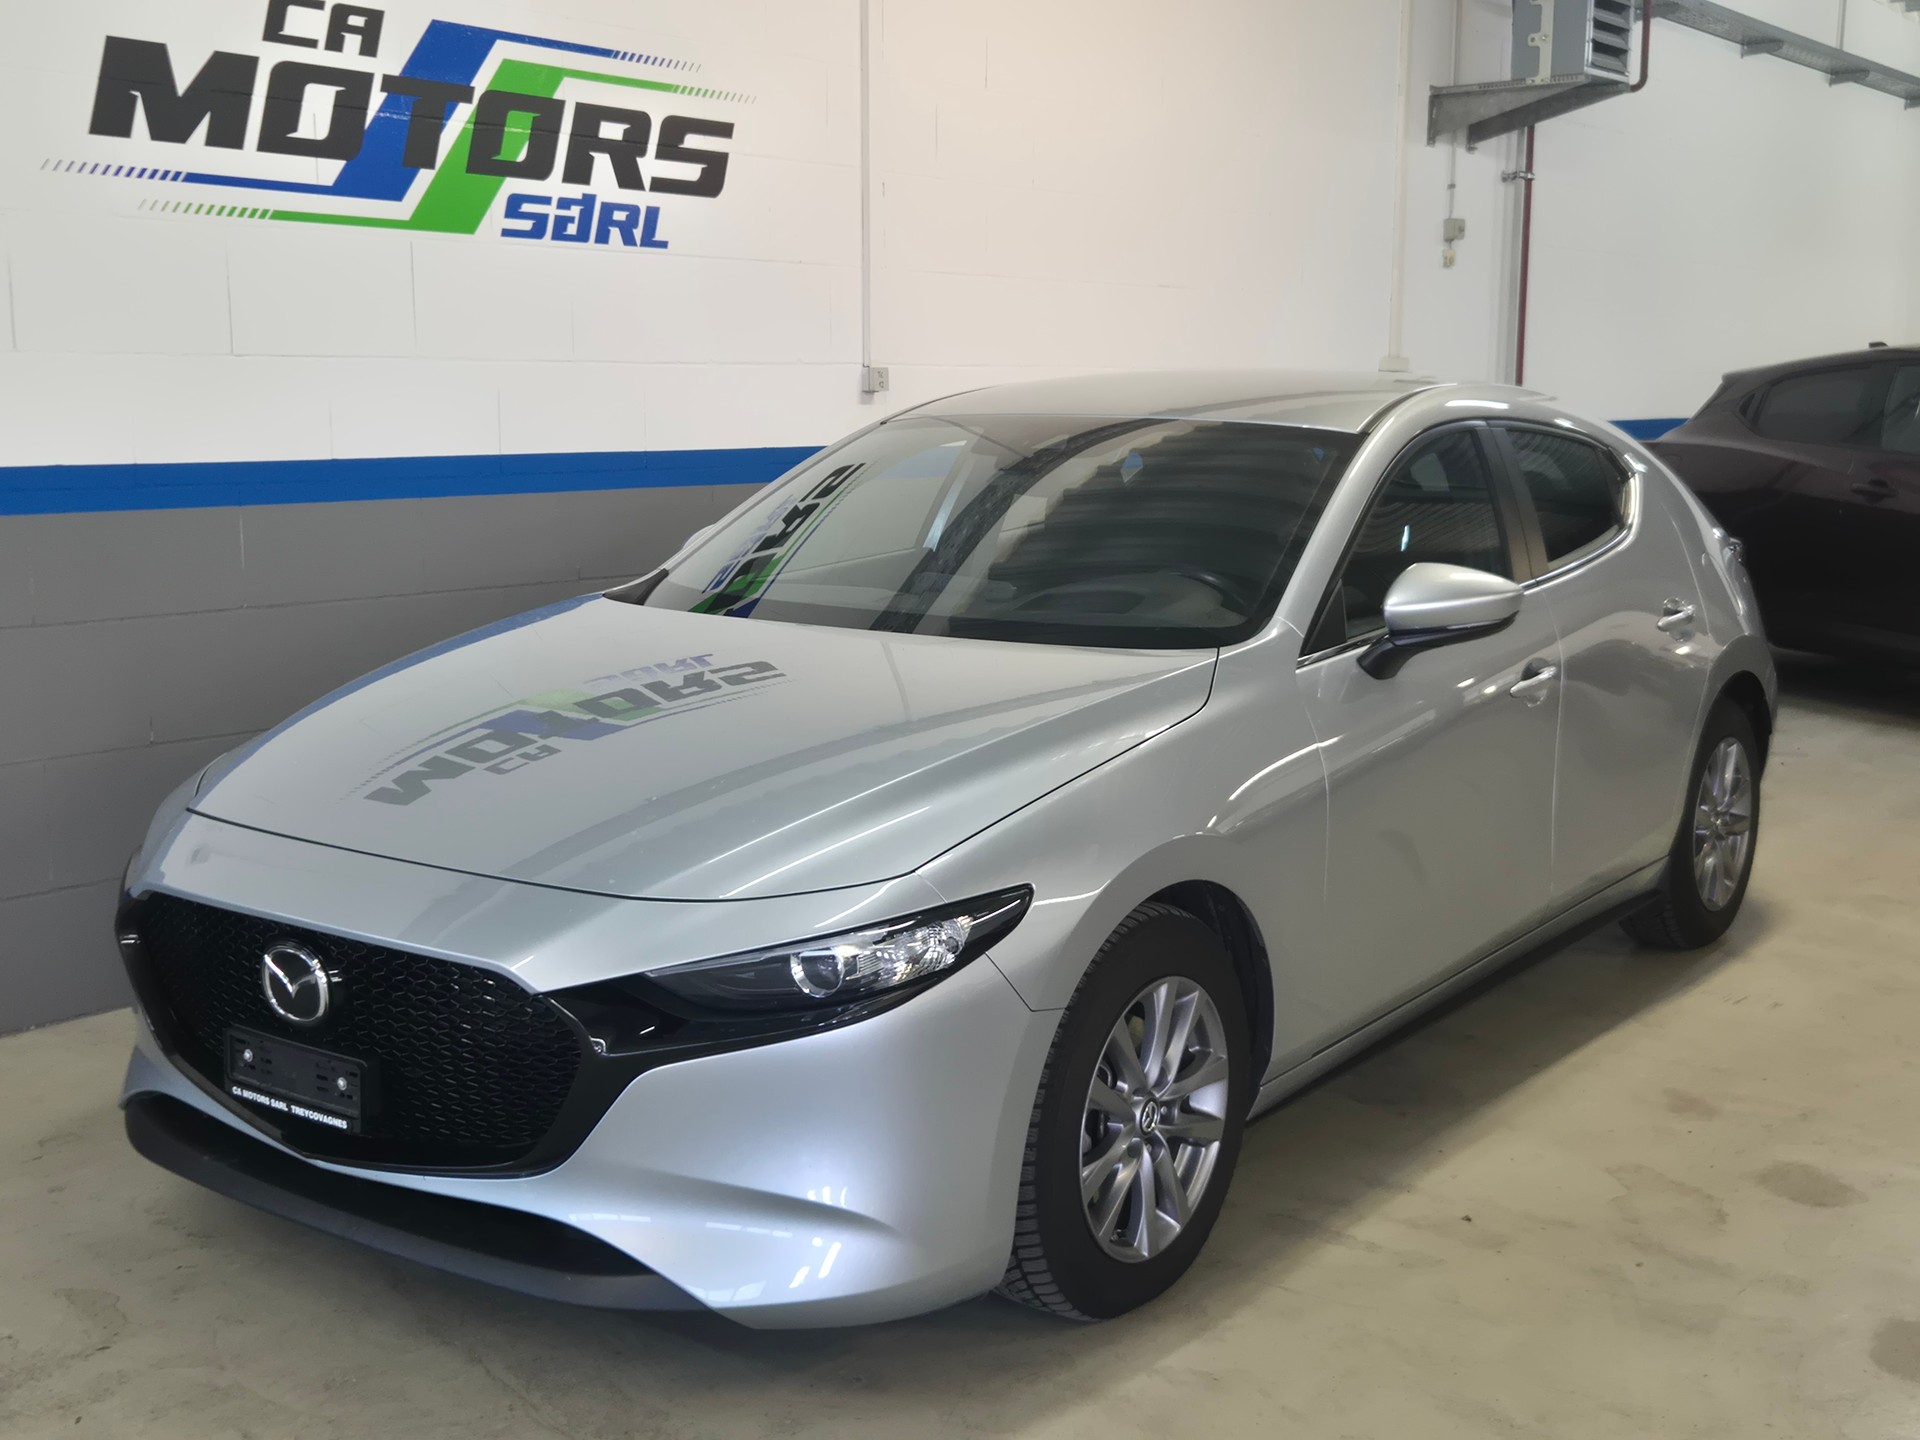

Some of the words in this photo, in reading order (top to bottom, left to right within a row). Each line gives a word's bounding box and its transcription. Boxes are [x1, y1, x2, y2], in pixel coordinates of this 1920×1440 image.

[262, 0, 385, 58] CA
[88, 35, 735, 199] MOTORS
[232, 1086, 242, 1096] CA
[243, 1089, 270, 1105] MOTORS
[271, 1099, 288, 1111] SARL
[291, 1105, 347, 1129] TREYCOVAGNES
